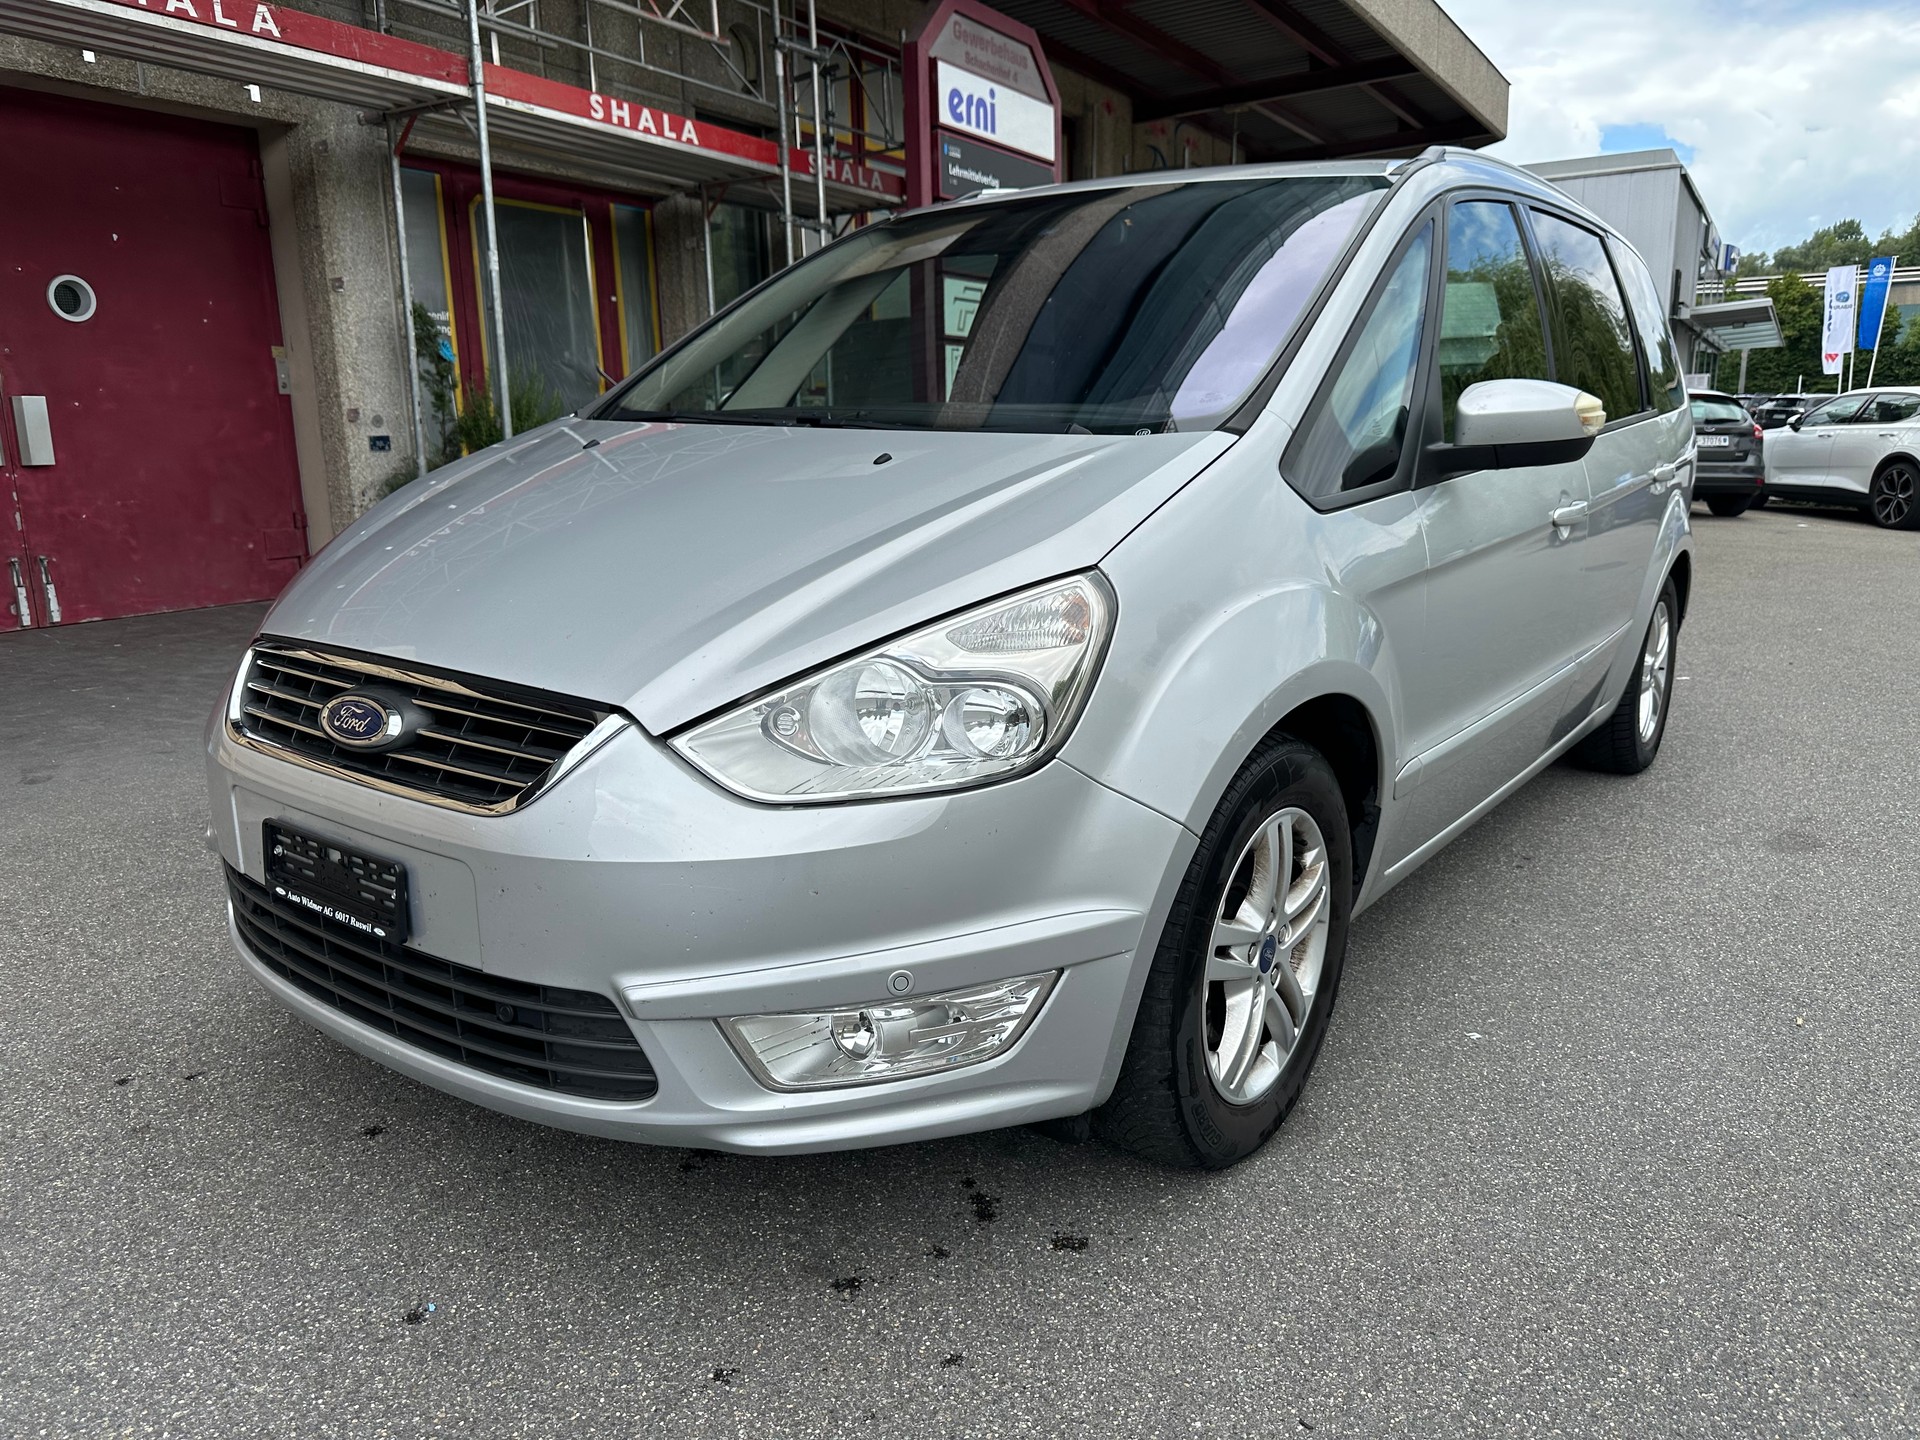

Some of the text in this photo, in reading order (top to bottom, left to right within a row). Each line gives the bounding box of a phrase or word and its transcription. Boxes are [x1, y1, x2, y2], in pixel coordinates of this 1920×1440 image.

[589, 93, 699, 145] SHALA
[948, 88, 996, 135] erni
[808, 153, 883, 192] SHALA
[948, 162, 1000, 189] Lehrmittelverlag
[333, 705, 371, 733] Ford
[287, 890, 372, 933] Auto Widmer AG 6017 Ruswil
